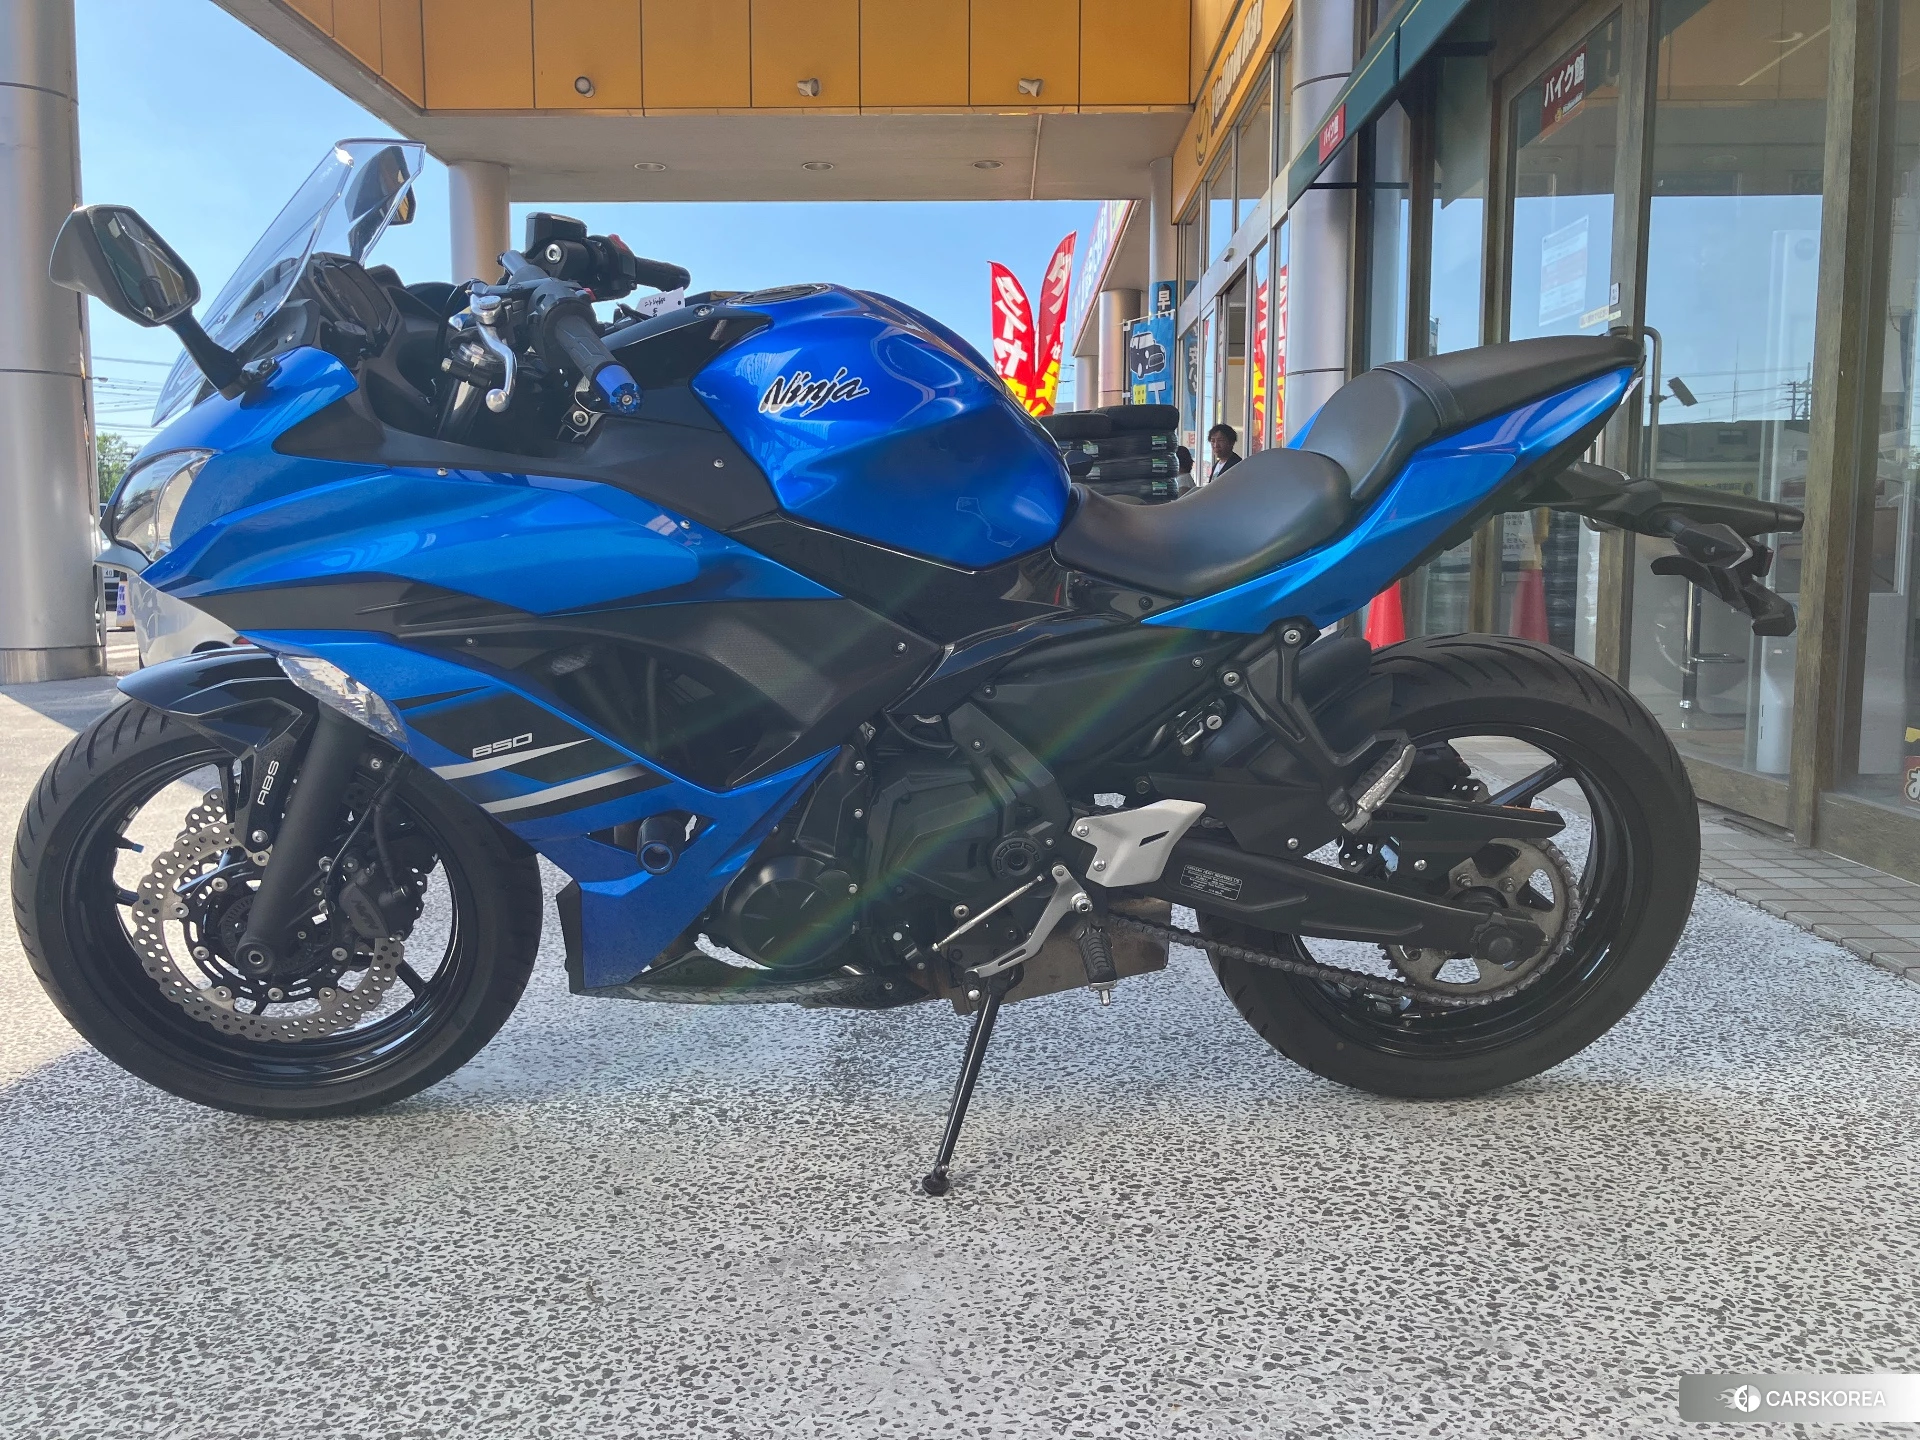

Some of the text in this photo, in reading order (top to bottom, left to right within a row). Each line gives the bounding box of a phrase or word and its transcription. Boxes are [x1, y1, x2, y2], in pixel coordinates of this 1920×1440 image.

[1543, 52, 1585, 108] バイク館
[759, 366, 870, 417] Ninja
[473, 732, 533, 759] 650
[257, 760, 280, 806] ABS
